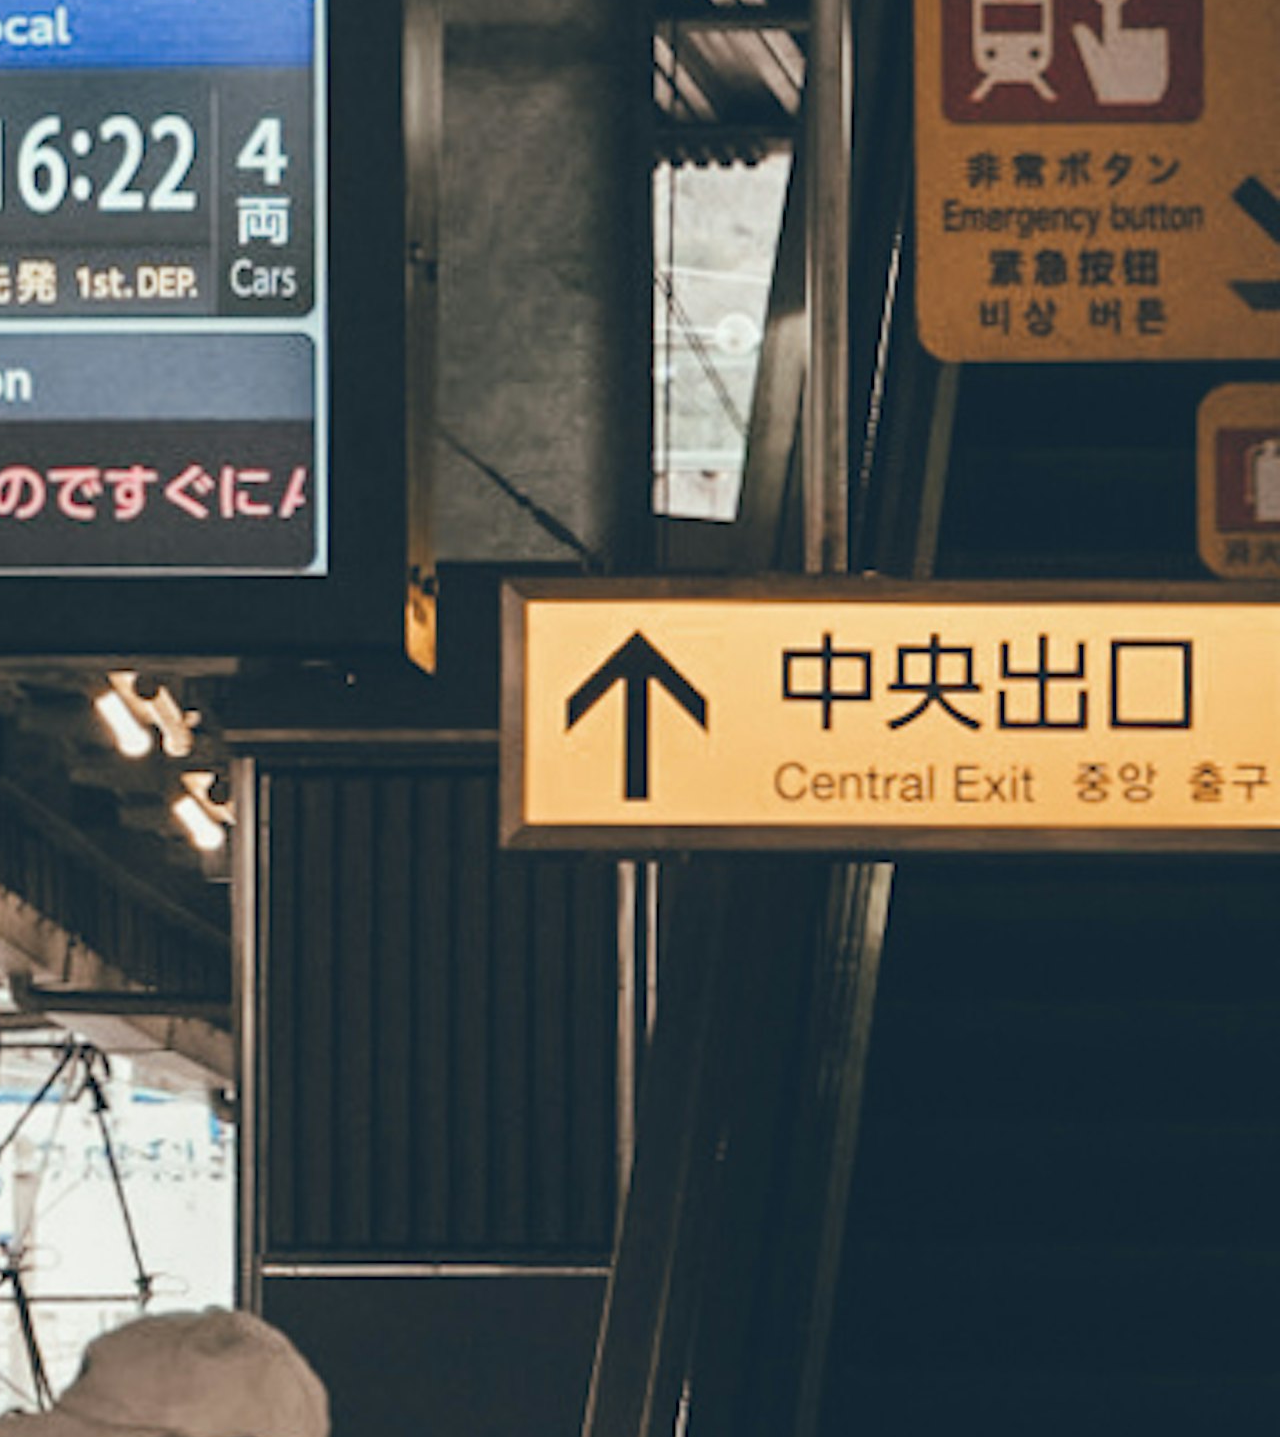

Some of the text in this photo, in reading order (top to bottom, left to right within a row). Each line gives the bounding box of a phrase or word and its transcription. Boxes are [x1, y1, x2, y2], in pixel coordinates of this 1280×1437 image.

[236, 117, 288, 186] 4
[966, 149, 1181, 189] 非常ボタン
[236, 196, 291, 246] 両
[942, 198, 1204, 238] Emergency button
[230, 258, 297, 298] Cars
[979, 298, 1168, 337] 비상 버튼
[781, 633, 1193, 731] 中央出口
[774, 762, 1036, 803] Central Exit
[1074, 762, 1271, 803] 중앙 출구
